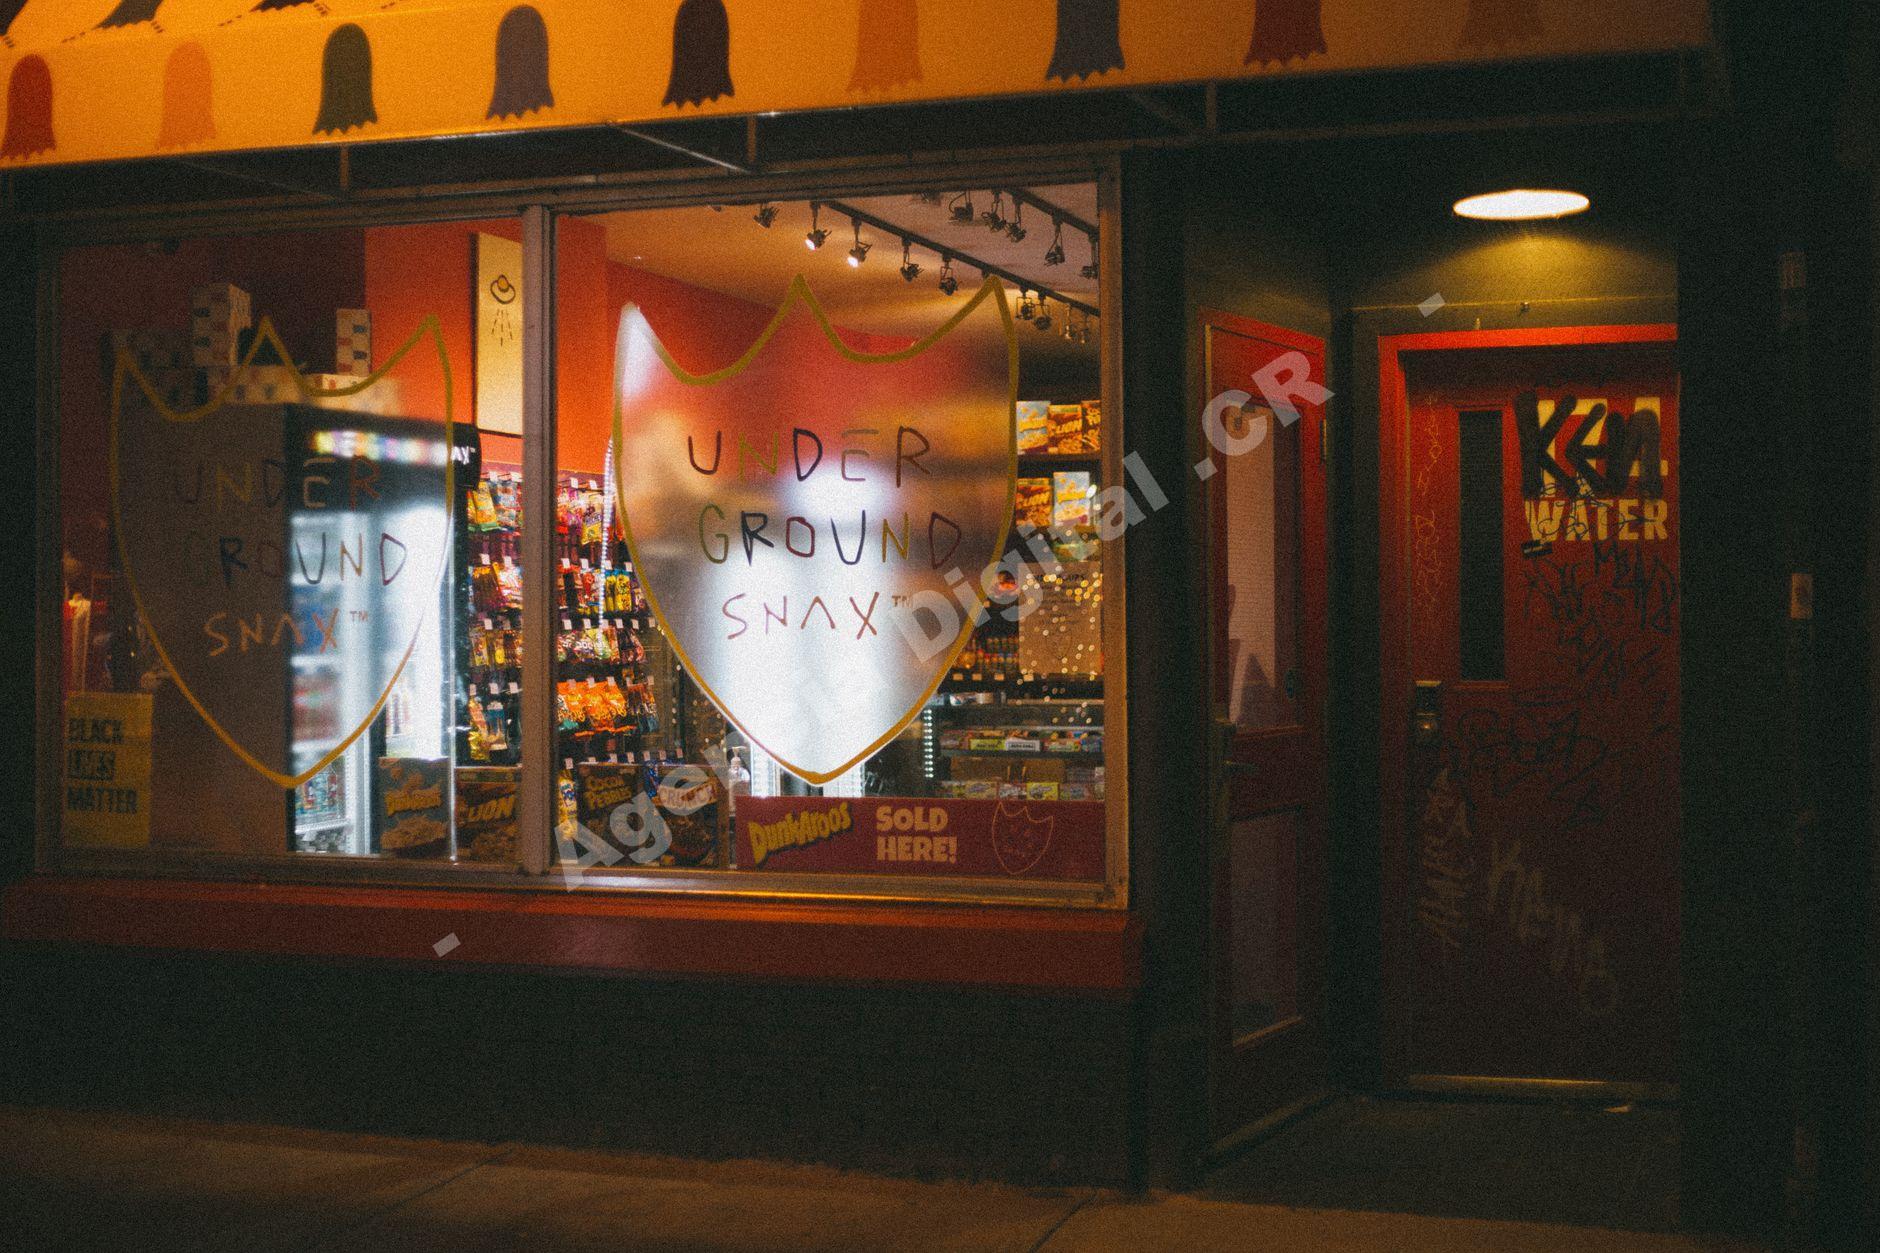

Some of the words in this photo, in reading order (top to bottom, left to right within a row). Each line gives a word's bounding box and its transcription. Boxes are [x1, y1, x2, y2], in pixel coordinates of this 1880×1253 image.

[687, 426, 931, 488] UNDER
[175, 456, 381, 511] UNDER
[699, 503, 962, 570] GROUND
[1523, 500, 1669, 543] WATER
[69, 718, 124, 744] BLACK
[67, 786, 137, 814] MATTER
[875, 805, 949, 832] SOLD
[875, 836, 958, 864] HERE!
